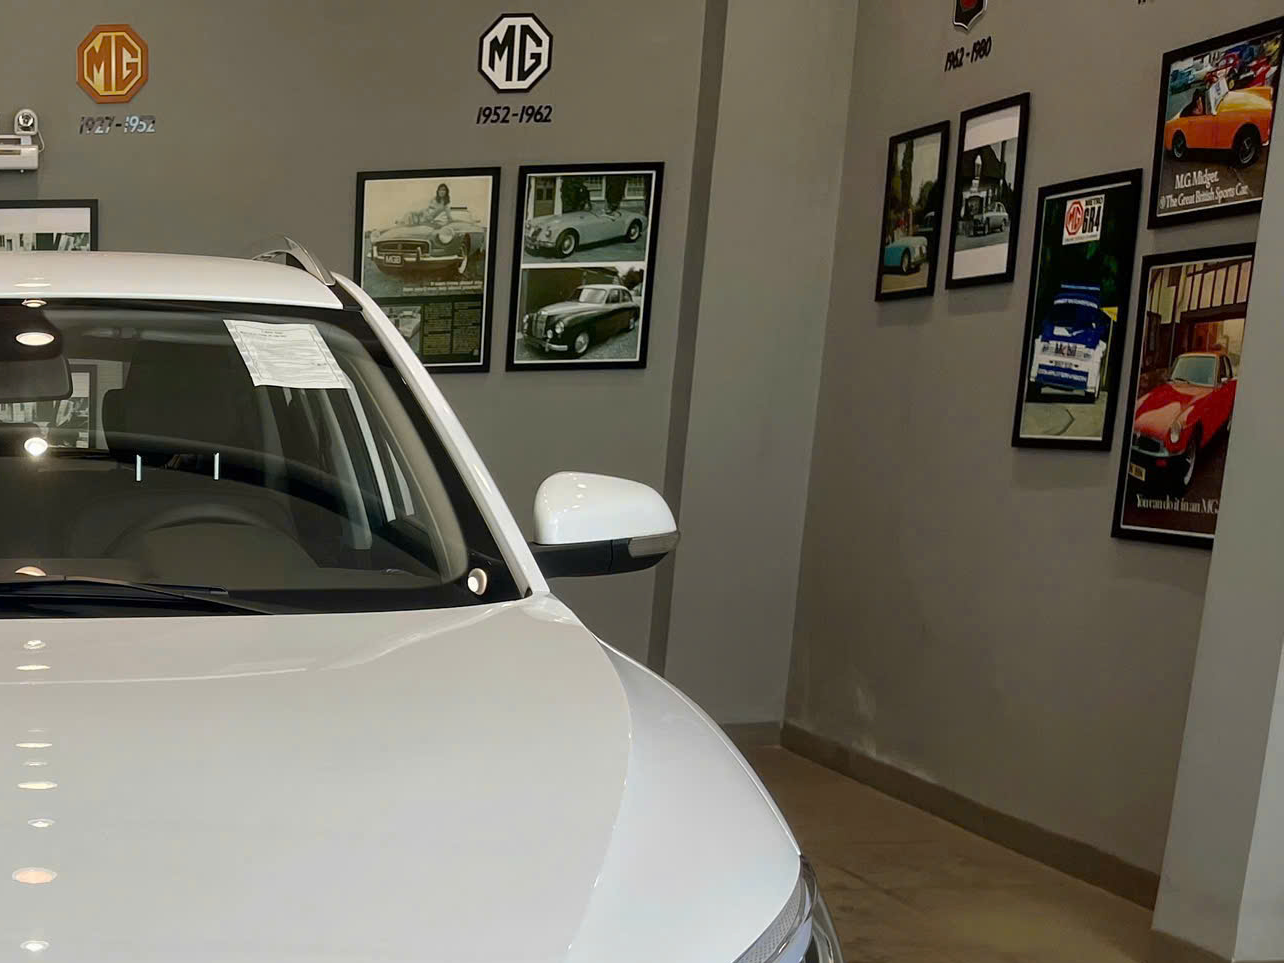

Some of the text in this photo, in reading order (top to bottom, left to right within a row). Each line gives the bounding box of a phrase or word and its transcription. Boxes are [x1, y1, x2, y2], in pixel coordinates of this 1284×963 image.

[84, 32, 142, 95] MG
[486, 22, 544, 83] MG
[476, 104, 553, 124] 1952-1962
